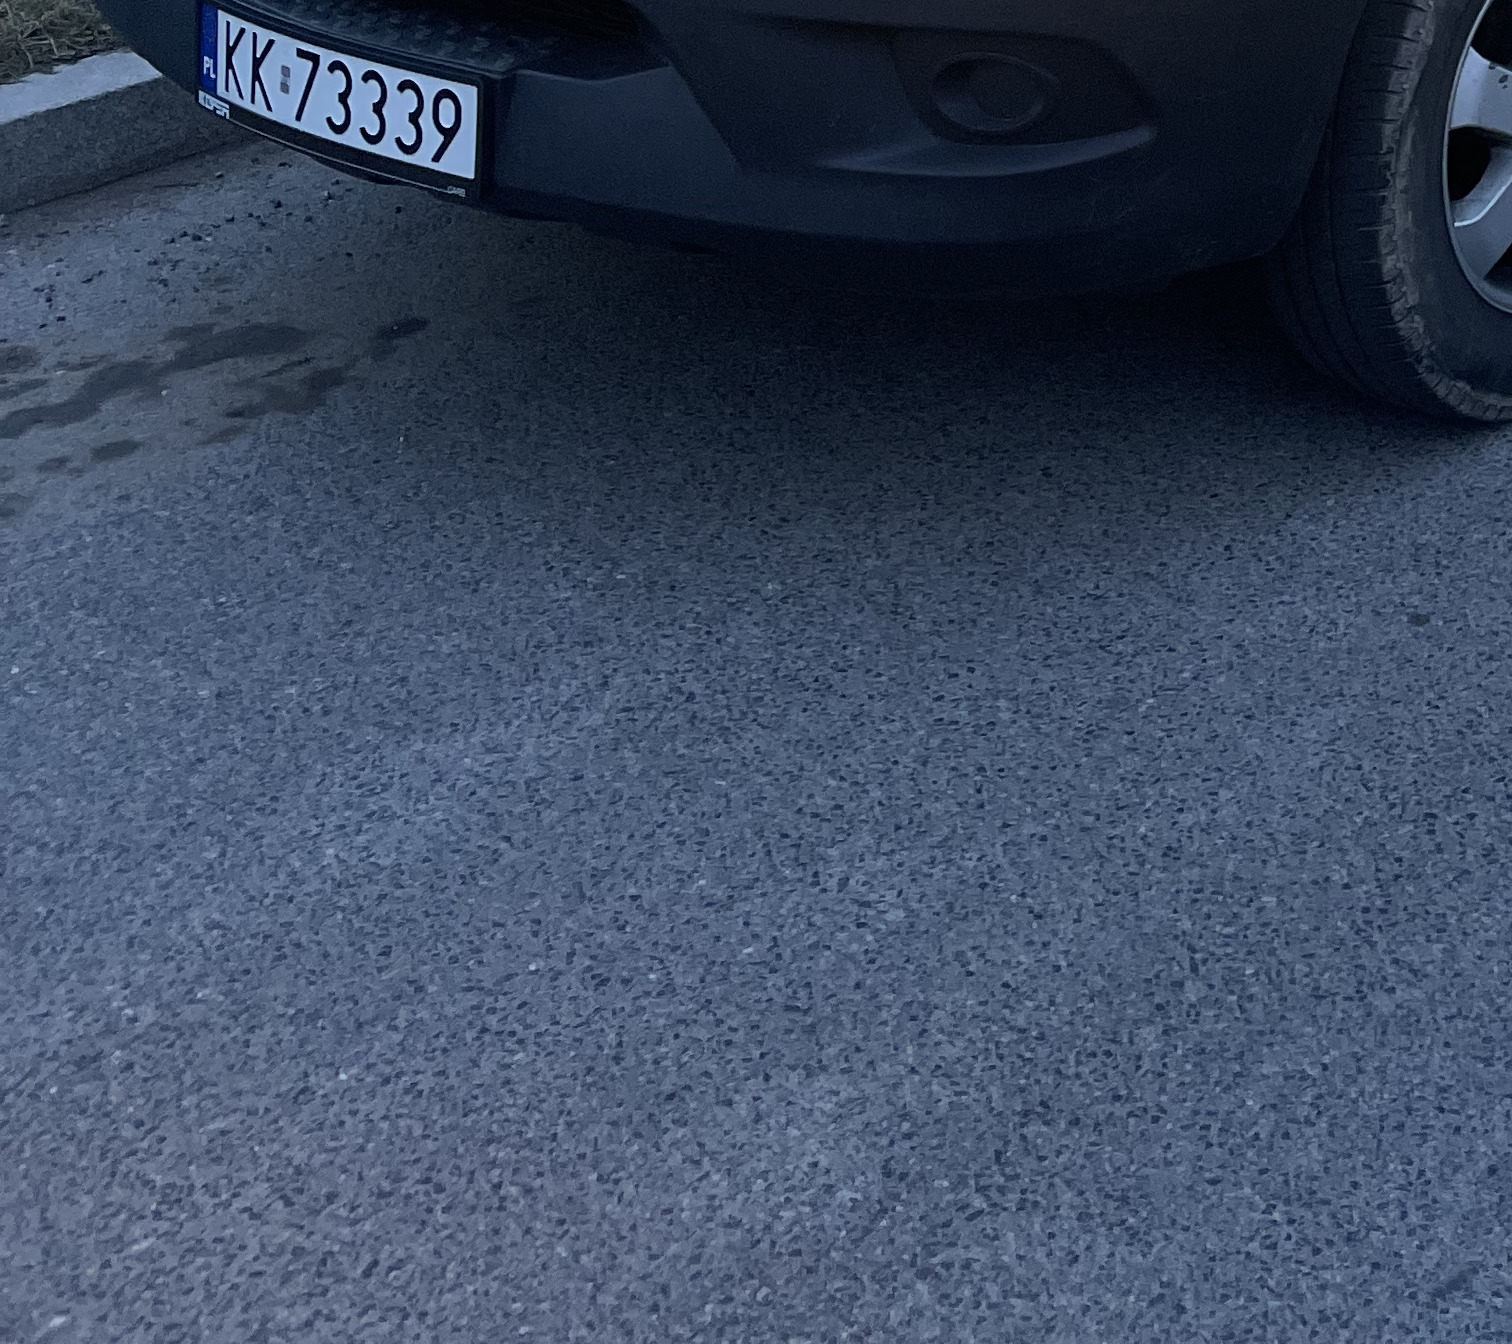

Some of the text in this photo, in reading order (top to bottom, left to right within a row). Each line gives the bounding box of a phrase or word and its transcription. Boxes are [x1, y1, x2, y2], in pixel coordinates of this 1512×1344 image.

[202, 55, 217, 80] PL
[224, 20, 463, 164] KK 73339
